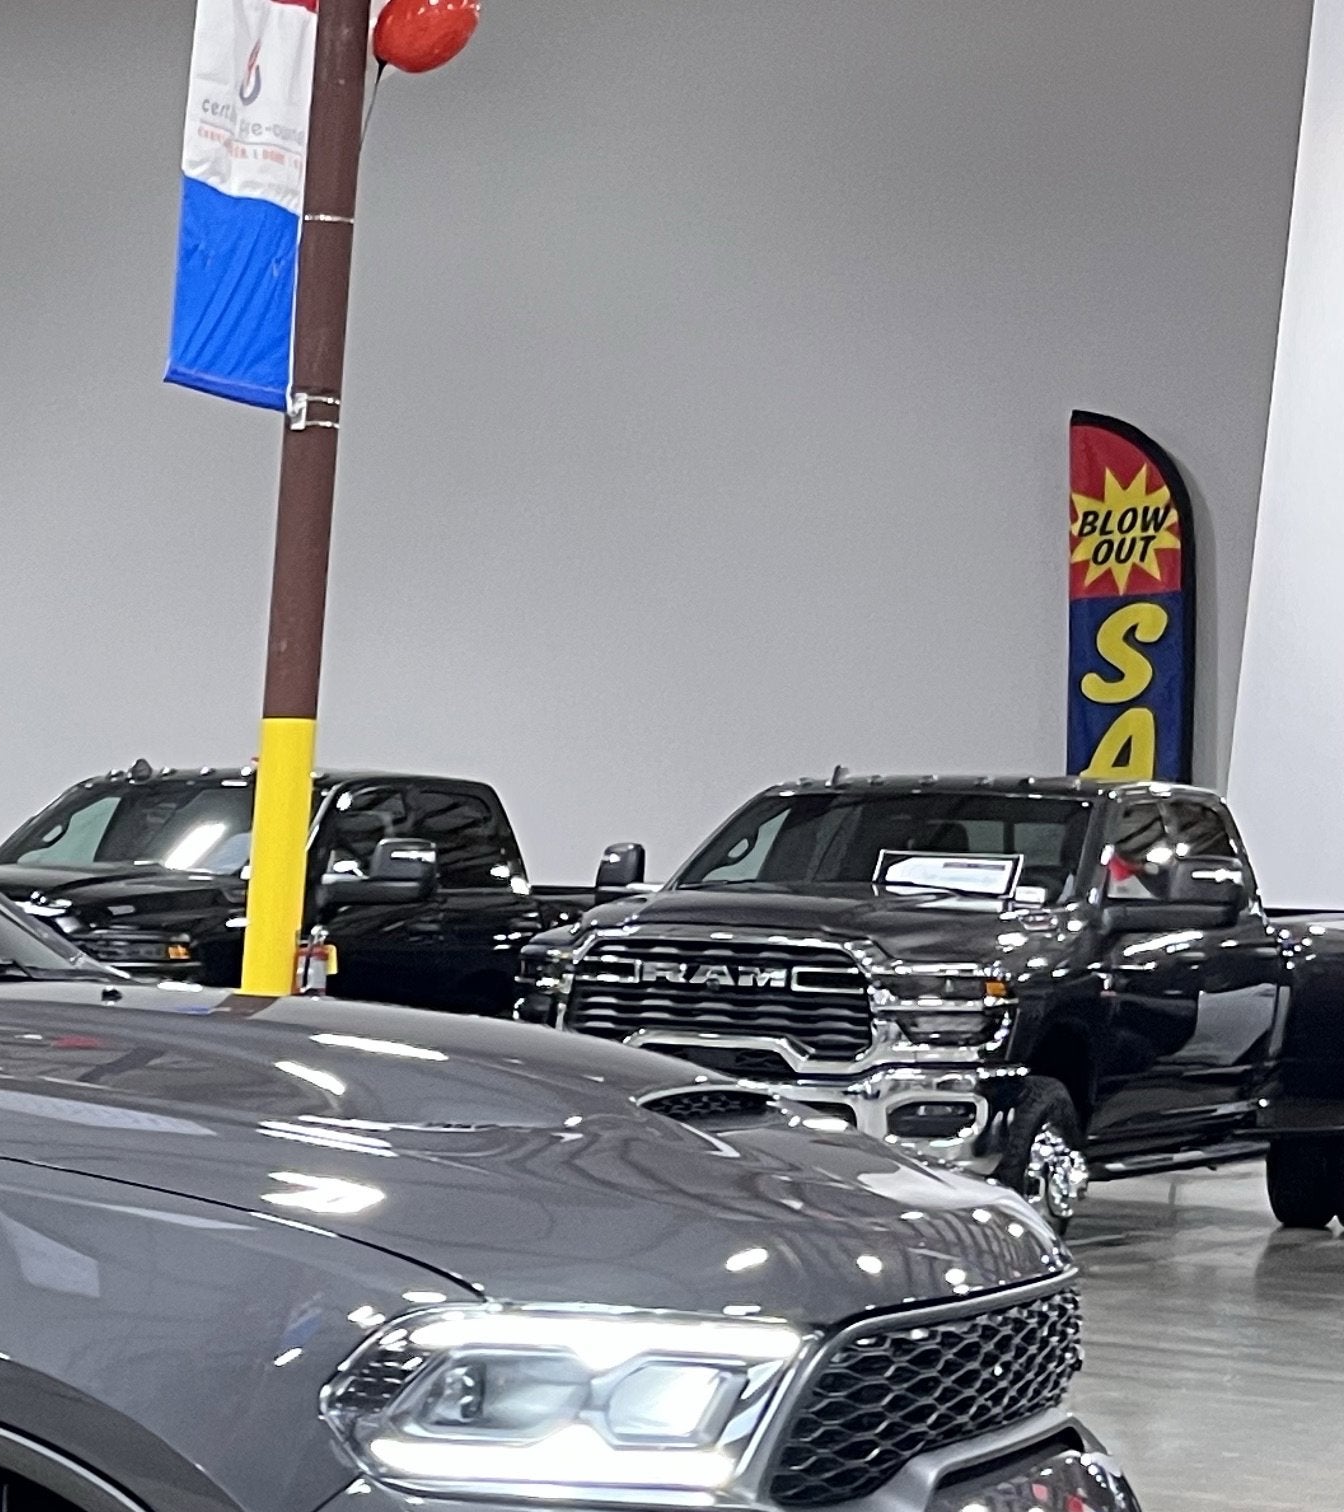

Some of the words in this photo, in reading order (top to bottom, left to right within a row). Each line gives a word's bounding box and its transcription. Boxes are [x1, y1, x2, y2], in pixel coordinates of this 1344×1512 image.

[1078, 505, 1171, 537] BLOW
[1091, 535, 1156, 566] OUT
[642, 961, 787, 988] RAM
